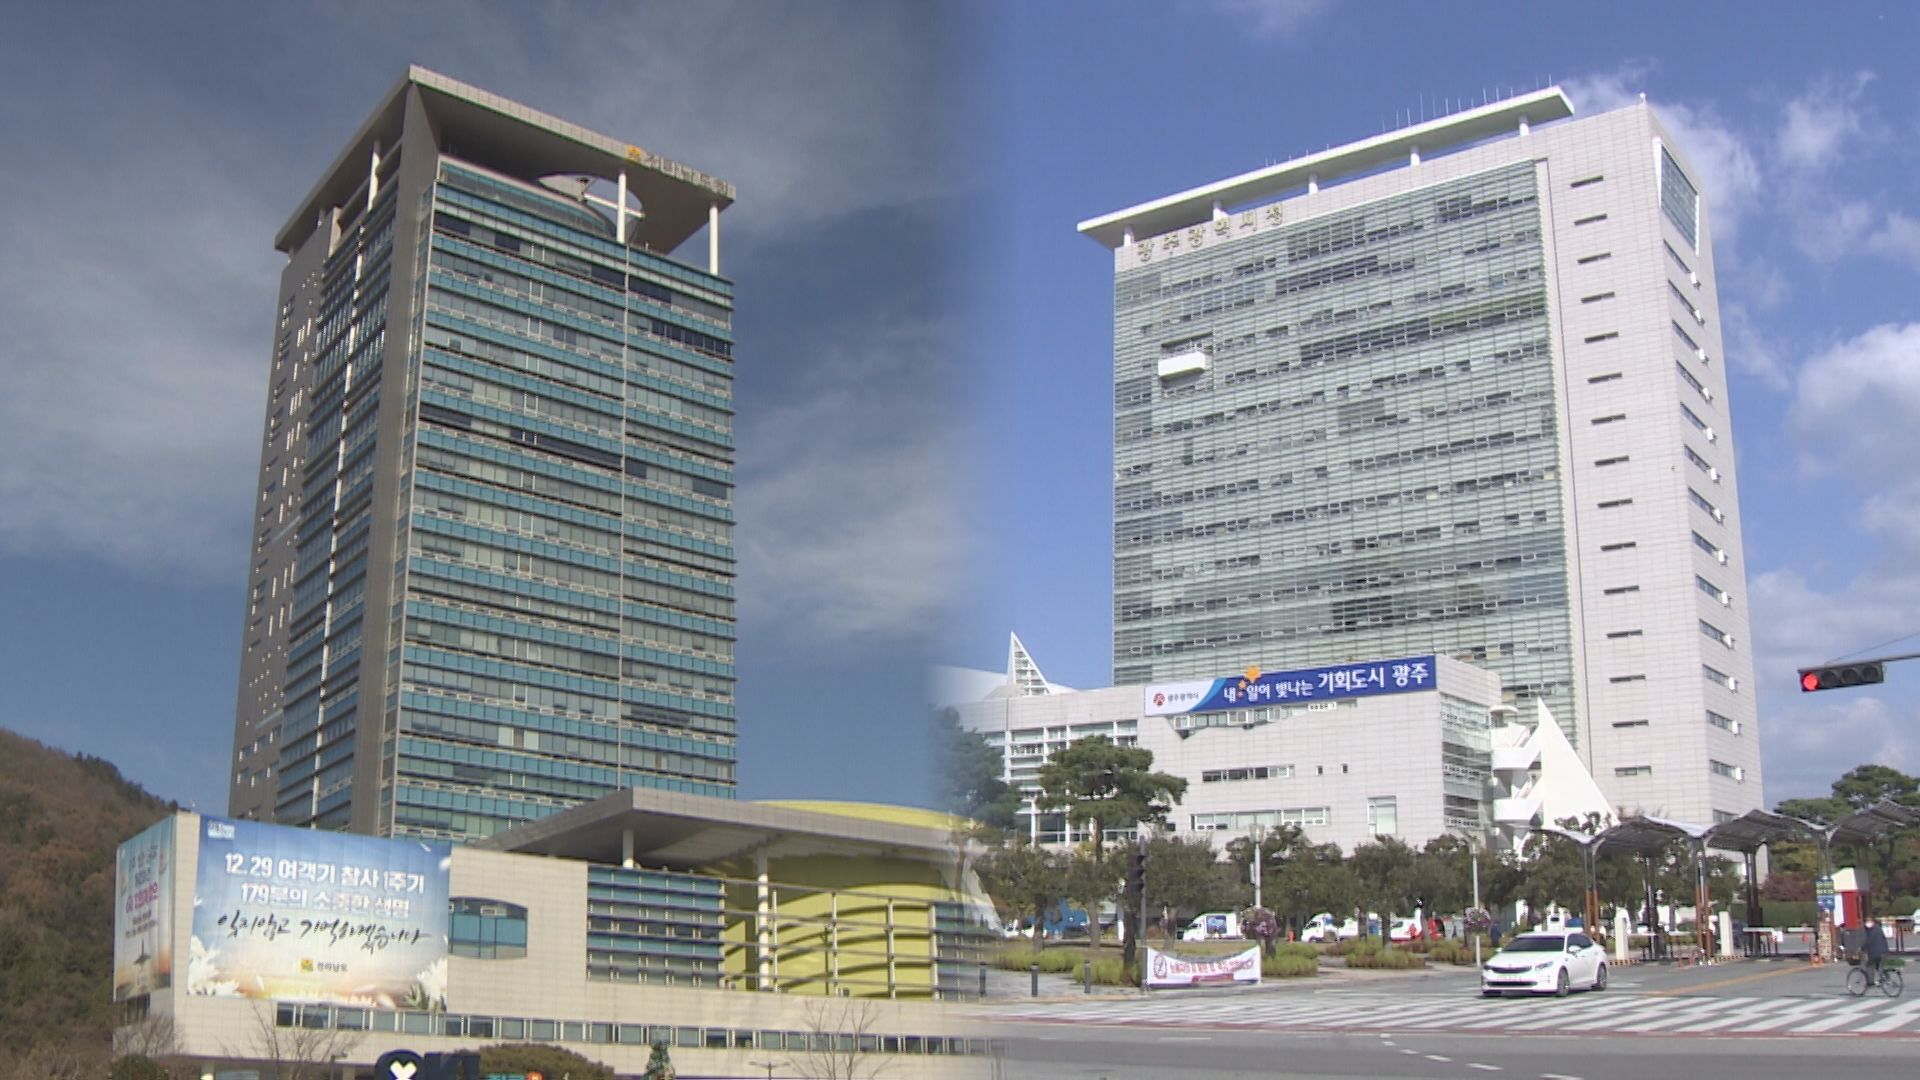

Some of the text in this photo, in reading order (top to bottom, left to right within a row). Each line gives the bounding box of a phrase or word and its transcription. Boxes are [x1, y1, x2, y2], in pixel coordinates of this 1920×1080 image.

[1275, 679, 1314, 698] 빛나는
[1317, 666, 1384, 693] 기회도시
[1392, 662, 1429, 687] 광주
[225, 852, 425, 894] 12.29 여객기 참사 1주기
[241, 882, 308, 908] 179분의
[300, 916, 431, 955] 기억하겠습니다
